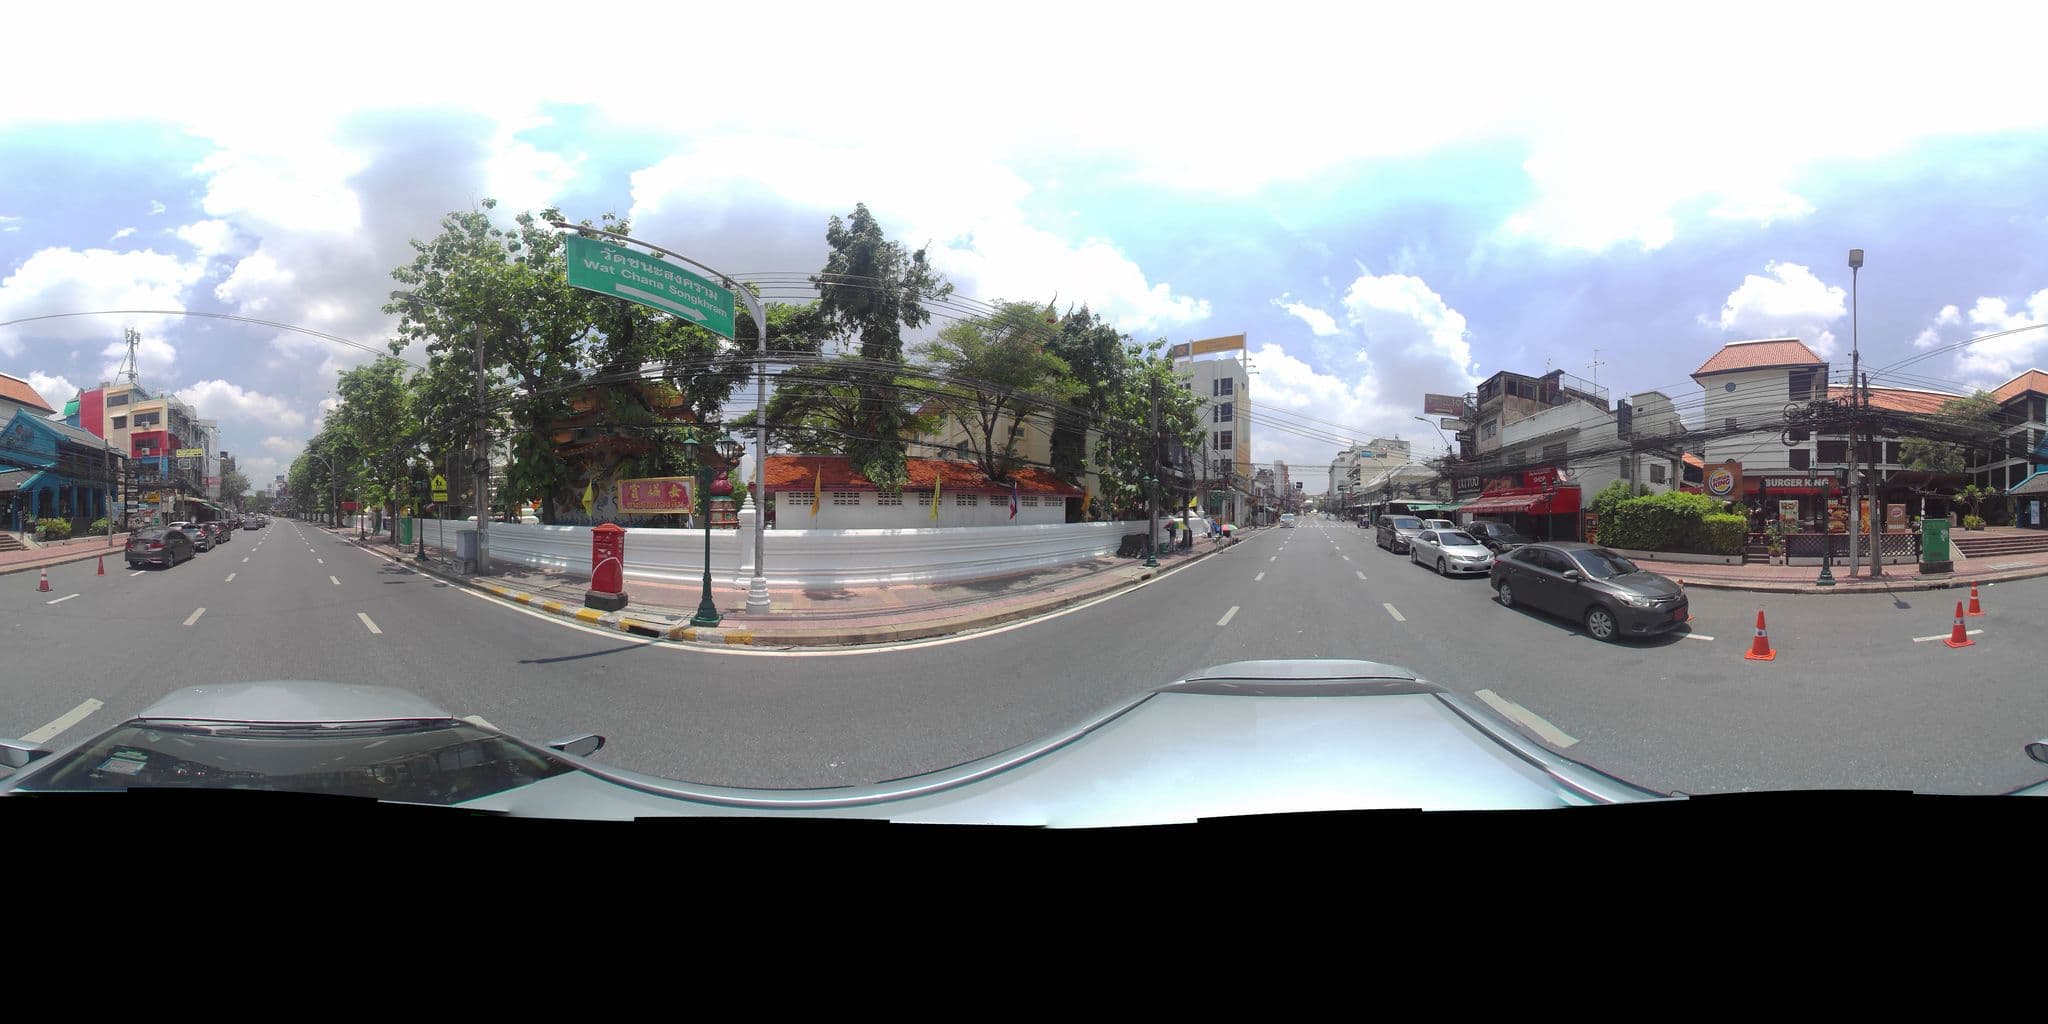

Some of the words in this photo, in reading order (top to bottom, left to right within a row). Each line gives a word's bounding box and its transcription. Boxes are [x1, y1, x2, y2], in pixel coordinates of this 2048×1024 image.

[583, 258, 615, 275] Wat
[620, 269, 664, 290] Chana
[668, 284, 727, 318] Songkhram
[600, 247, 718, 300] วัดชนะสงคราม
[1713, 478, 1731, 488] KING
[1765, 478, 1803, 487] BURGER
[1804, 478, 1829, 487] KNG
